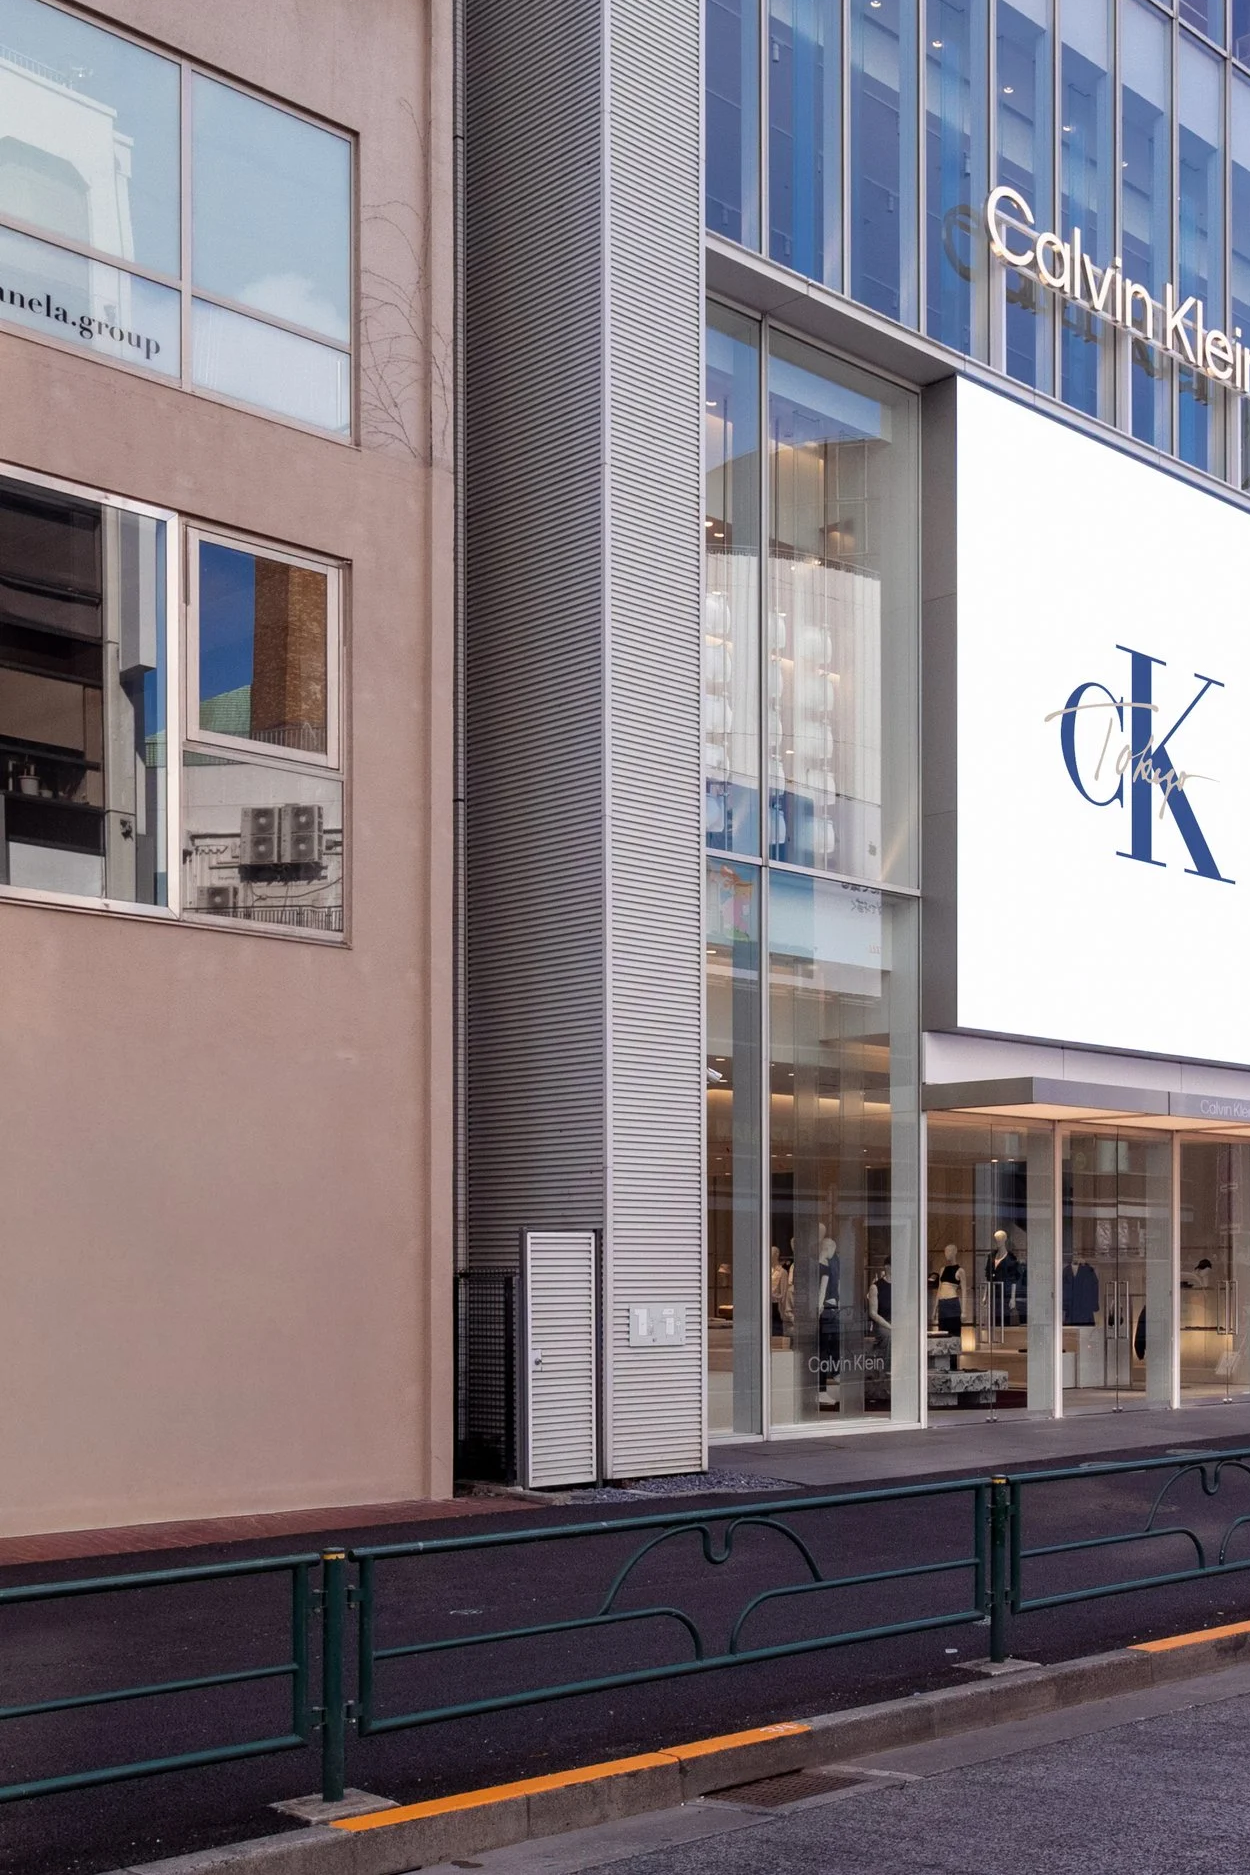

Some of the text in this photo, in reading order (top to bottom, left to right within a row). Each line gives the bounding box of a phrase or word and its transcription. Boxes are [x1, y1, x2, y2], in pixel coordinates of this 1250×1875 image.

[985, 185, 1153, 341] Calvin
[1044, 702, 1220, 819] Tokyo
[1200, 1099, 1232, 1116] Calvin
[808, 1354, 885, 1373] Calvin Klein
